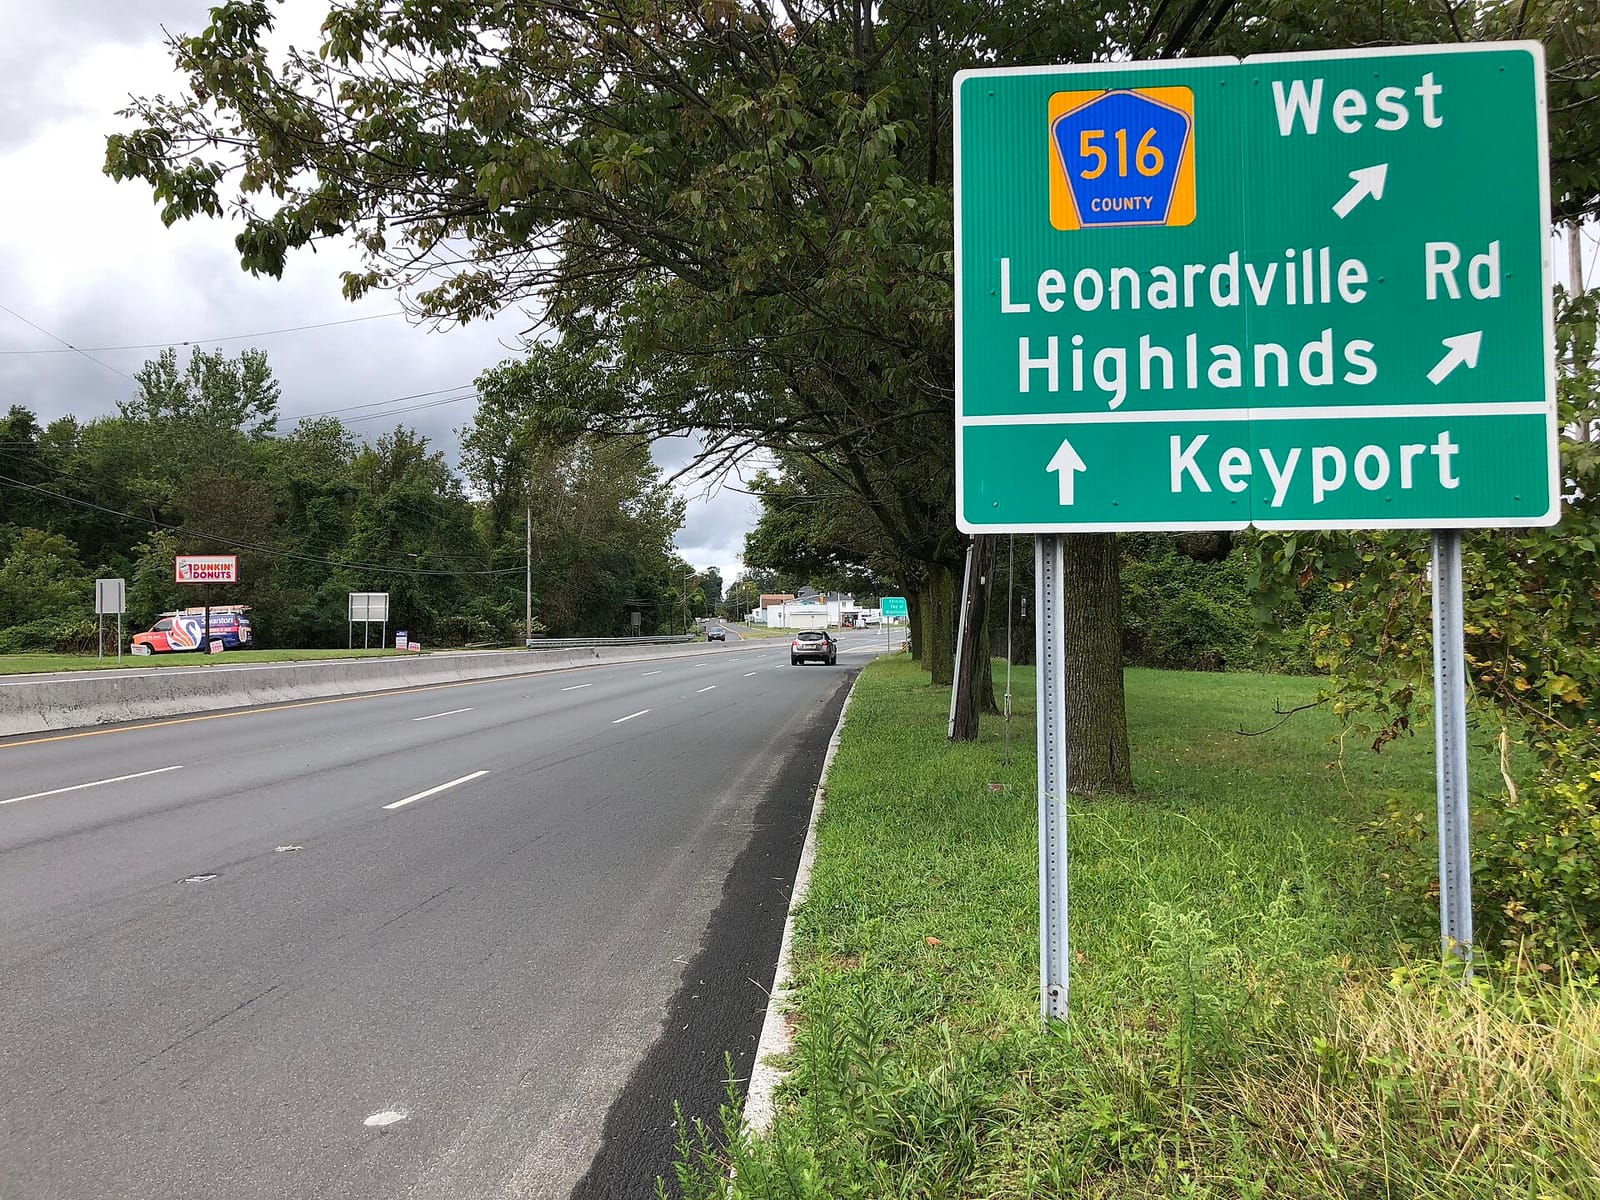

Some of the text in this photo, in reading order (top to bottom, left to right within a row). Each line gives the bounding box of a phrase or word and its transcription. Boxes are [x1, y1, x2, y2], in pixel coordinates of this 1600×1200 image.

[1273, 73, 1443, 136] West
[1079, 128, 1165, 180] 516
[1091, 196, 1153, 212] COUNTY
[1000, 240, 1501, 314] Leonardville Rd
[1018, 327, 1378, 411] Highlands
[1170, 430, 1460, 507] Keyport
[193, 571, 231, 579] DONUTS
